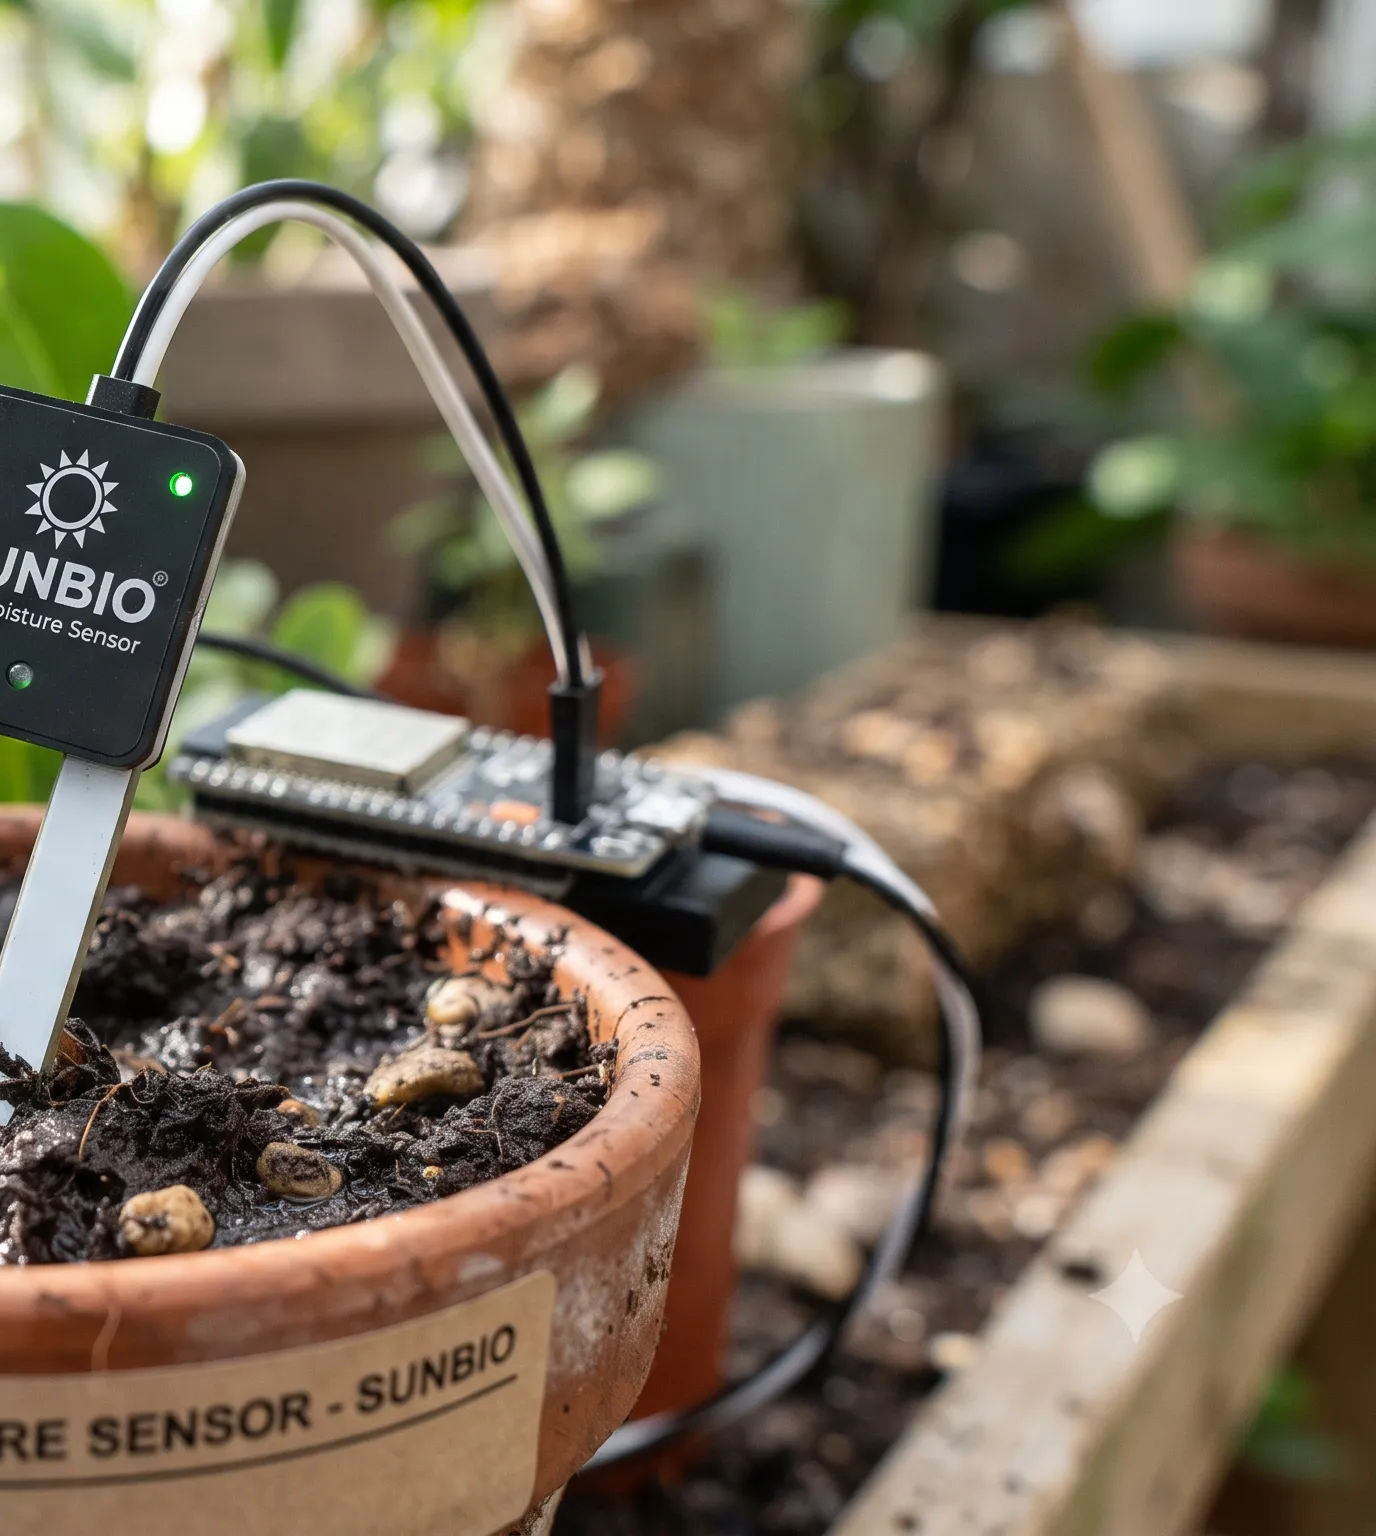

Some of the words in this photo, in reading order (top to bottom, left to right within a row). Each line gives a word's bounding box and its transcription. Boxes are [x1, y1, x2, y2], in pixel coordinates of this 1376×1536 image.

[67, 620, 141, 654] Sensor
[87, 1390, 312, 1459] SENSOR
[355, 1322, 517, 1415] SUNBIO
